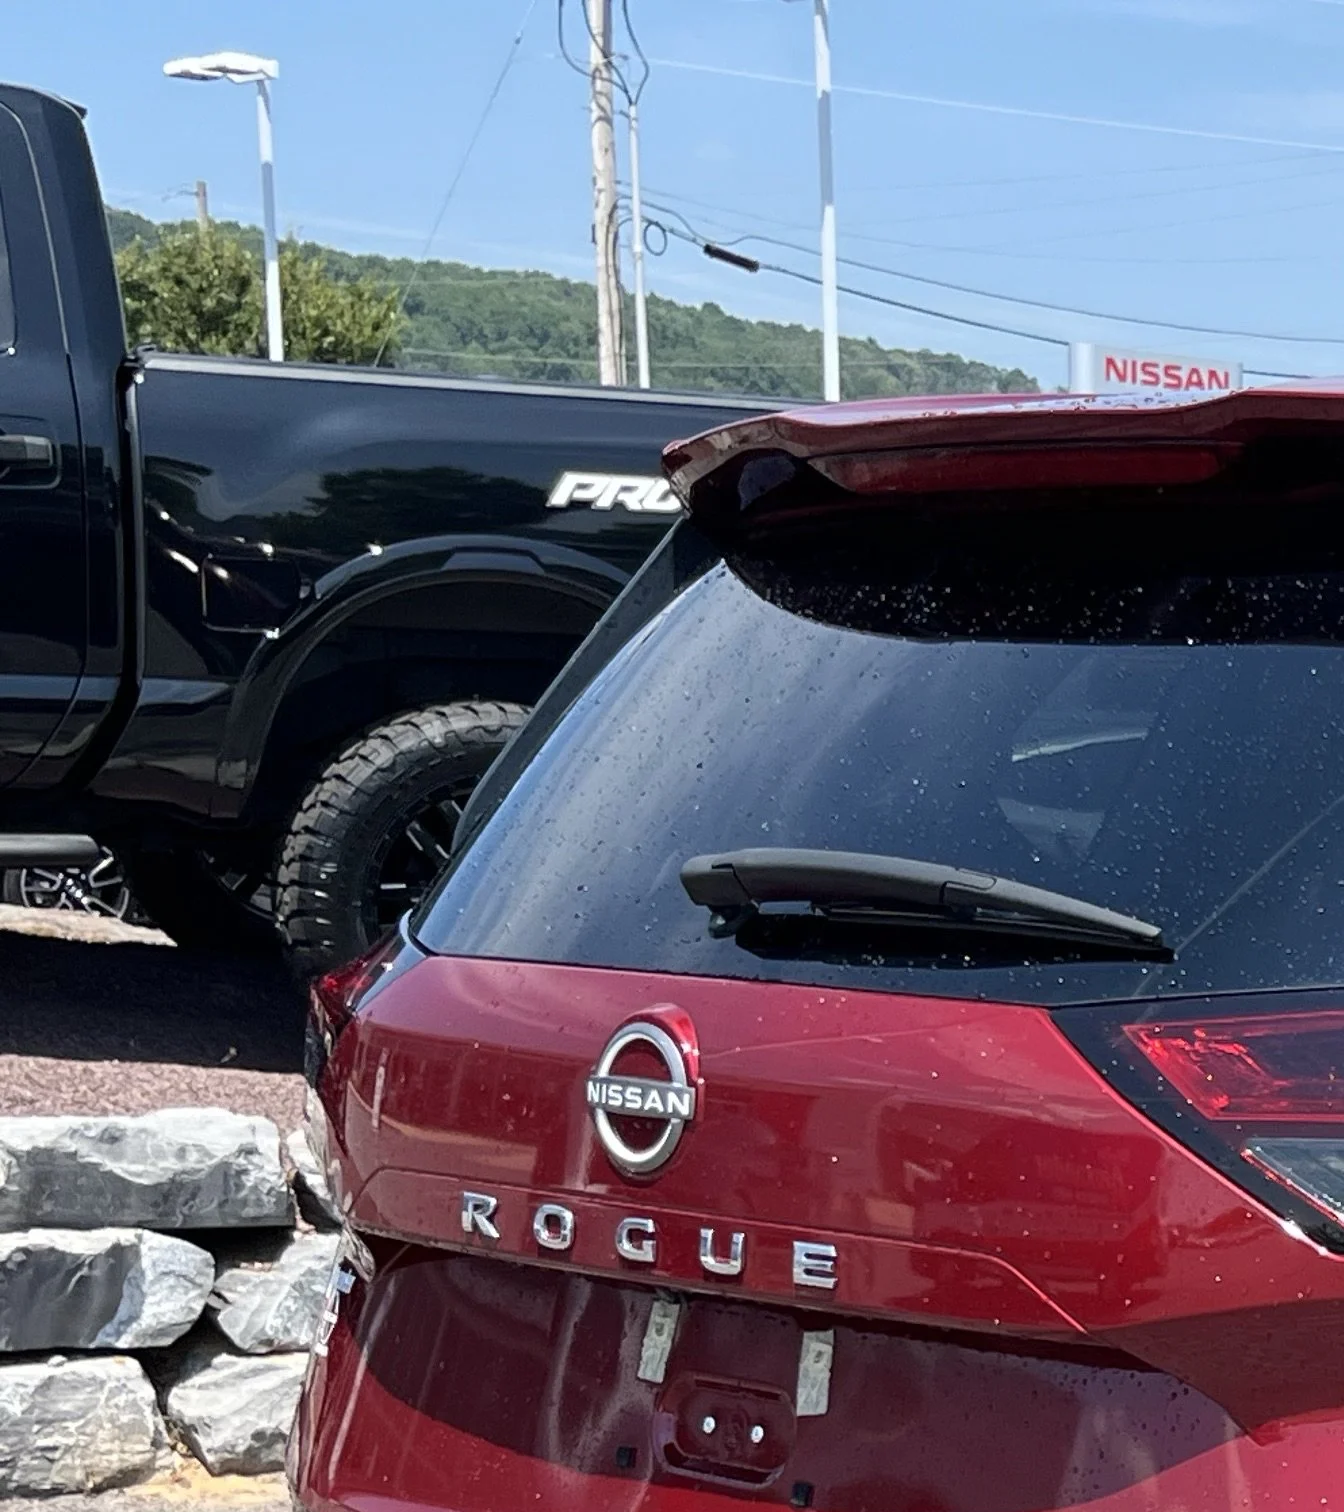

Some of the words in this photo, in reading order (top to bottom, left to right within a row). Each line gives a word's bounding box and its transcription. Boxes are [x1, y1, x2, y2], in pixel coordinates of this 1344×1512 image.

[1104, 355, 1230, 390] NISSAN
[586, 1080, 690, 1116] NISSAN
[461, 1190, 840, 1290] ROGUE
